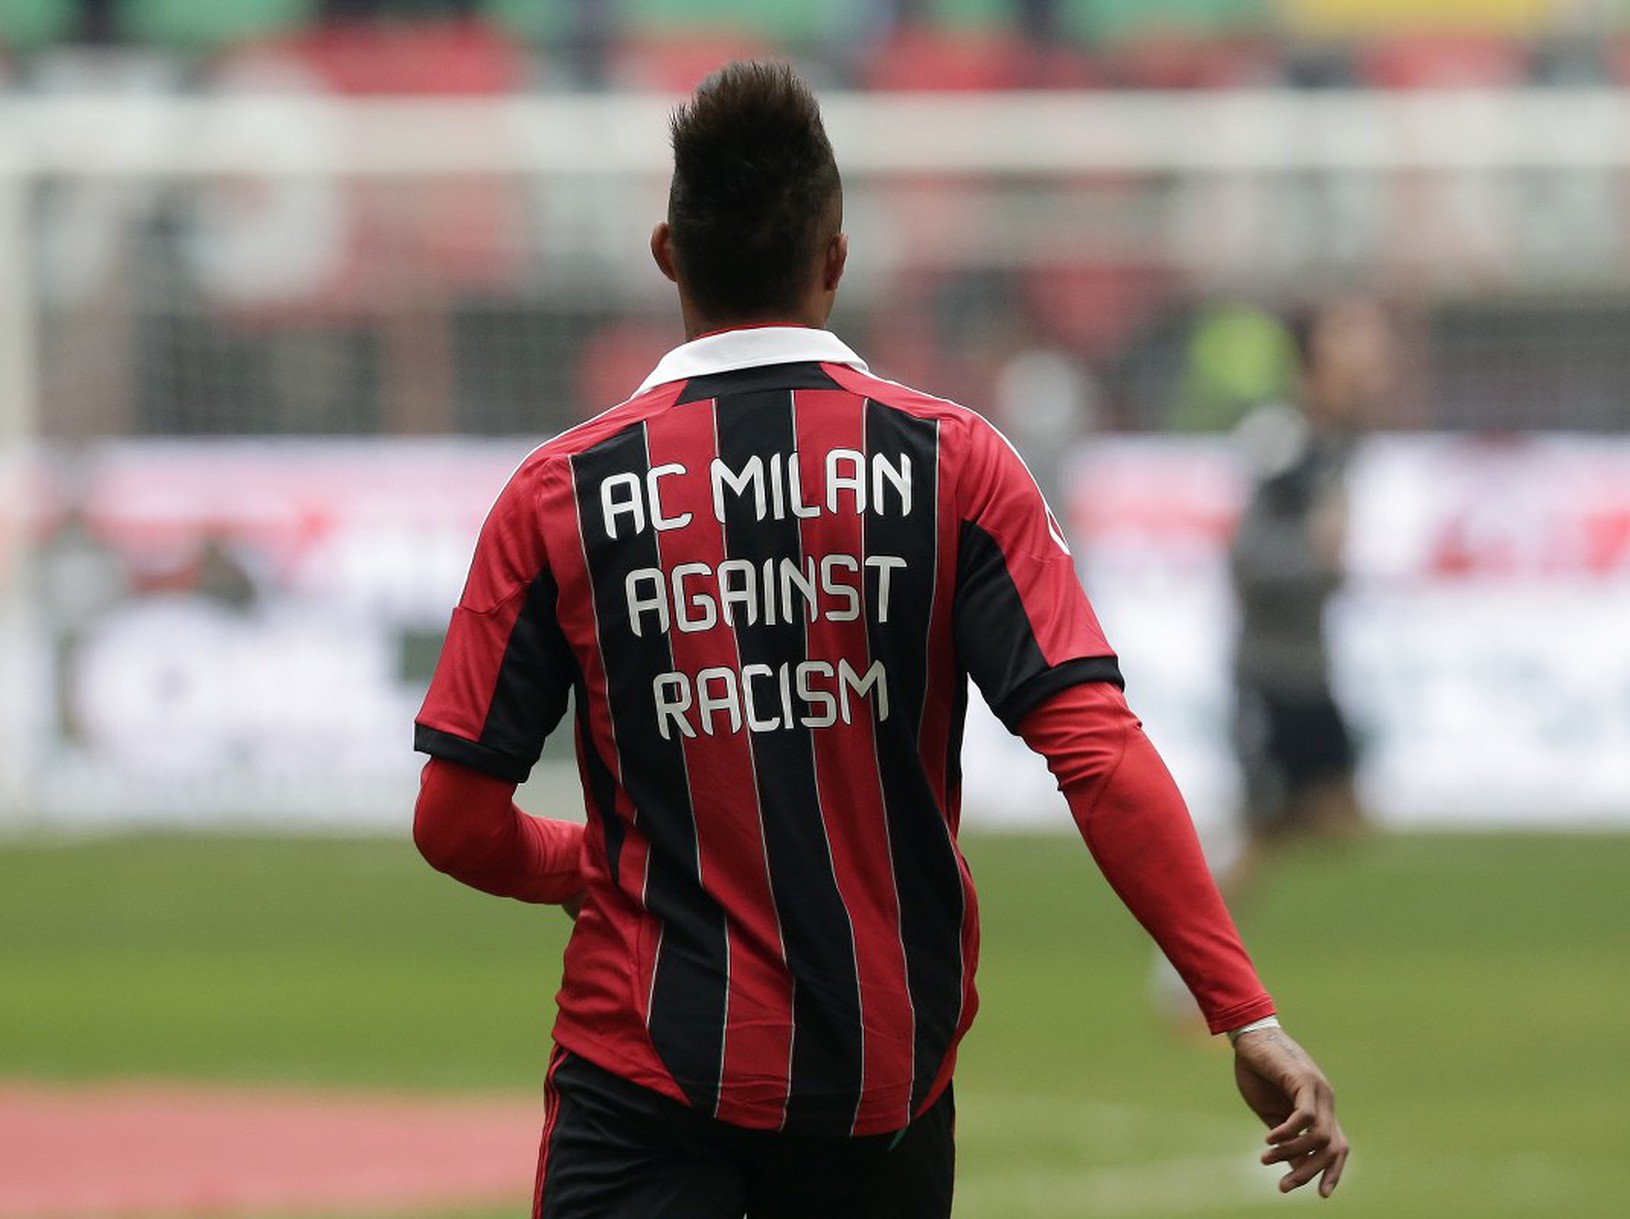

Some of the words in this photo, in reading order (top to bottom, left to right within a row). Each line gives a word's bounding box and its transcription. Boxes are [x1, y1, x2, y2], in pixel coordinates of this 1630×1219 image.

[600, 463, 692, 539] AC
[710, 448, 912, 524] MILAN
[625, 554, 907, 637] AGAINST
[653, 659, 889, 740] RACISM
